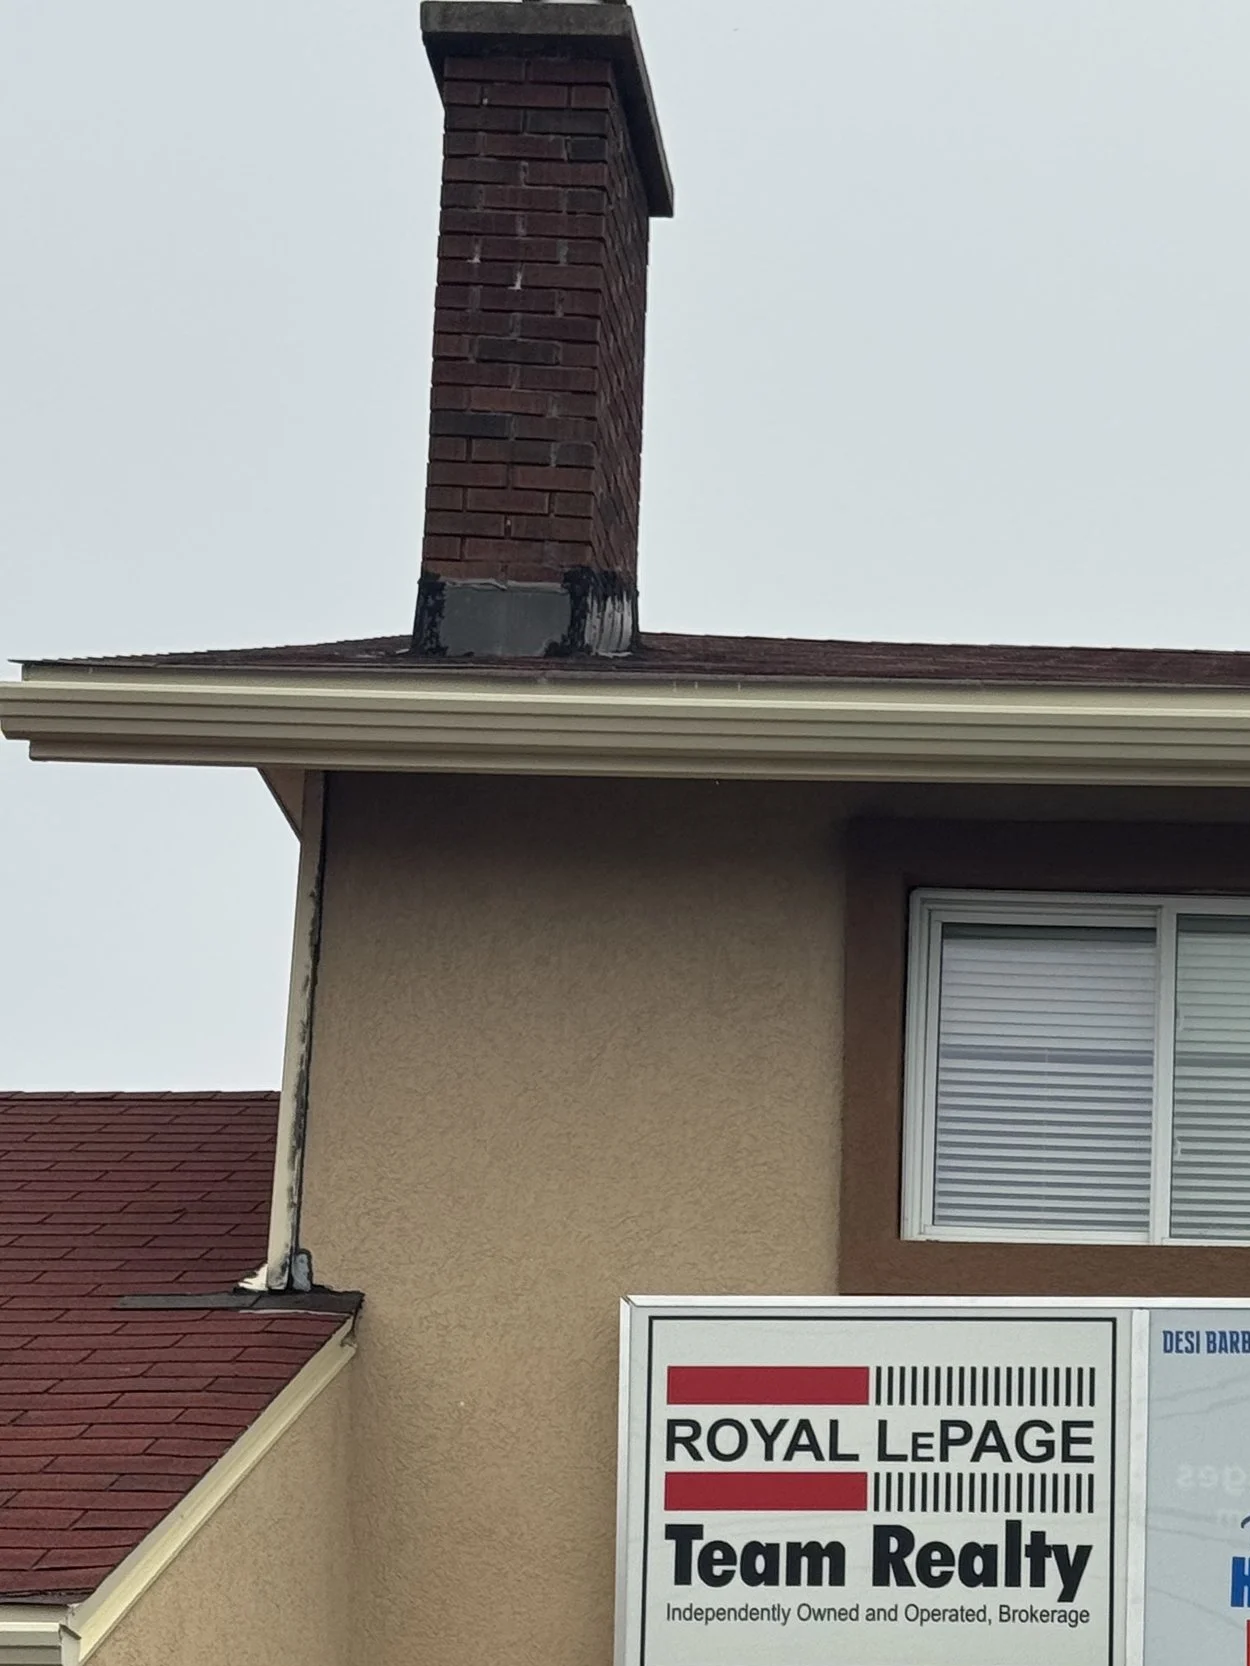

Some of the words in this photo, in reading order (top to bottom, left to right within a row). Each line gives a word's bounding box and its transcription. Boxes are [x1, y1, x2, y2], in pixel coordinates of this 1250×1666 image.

[1162, 1330, 1201, 1355] DESI
[666, 1418, 860, 1463] ROYAL
[664, 1523, 845, 1588] Team
[871, 1519, 1093, 1603] Realty
[666, 1602, 791, 1627] Independently
[797, 1603, 860, 1623] Owned
[865, 1603, 899, 1623] and
[904, 1603, 992, 1627] Operated,
[998, 1604, 1091, 1628] Brokerage
